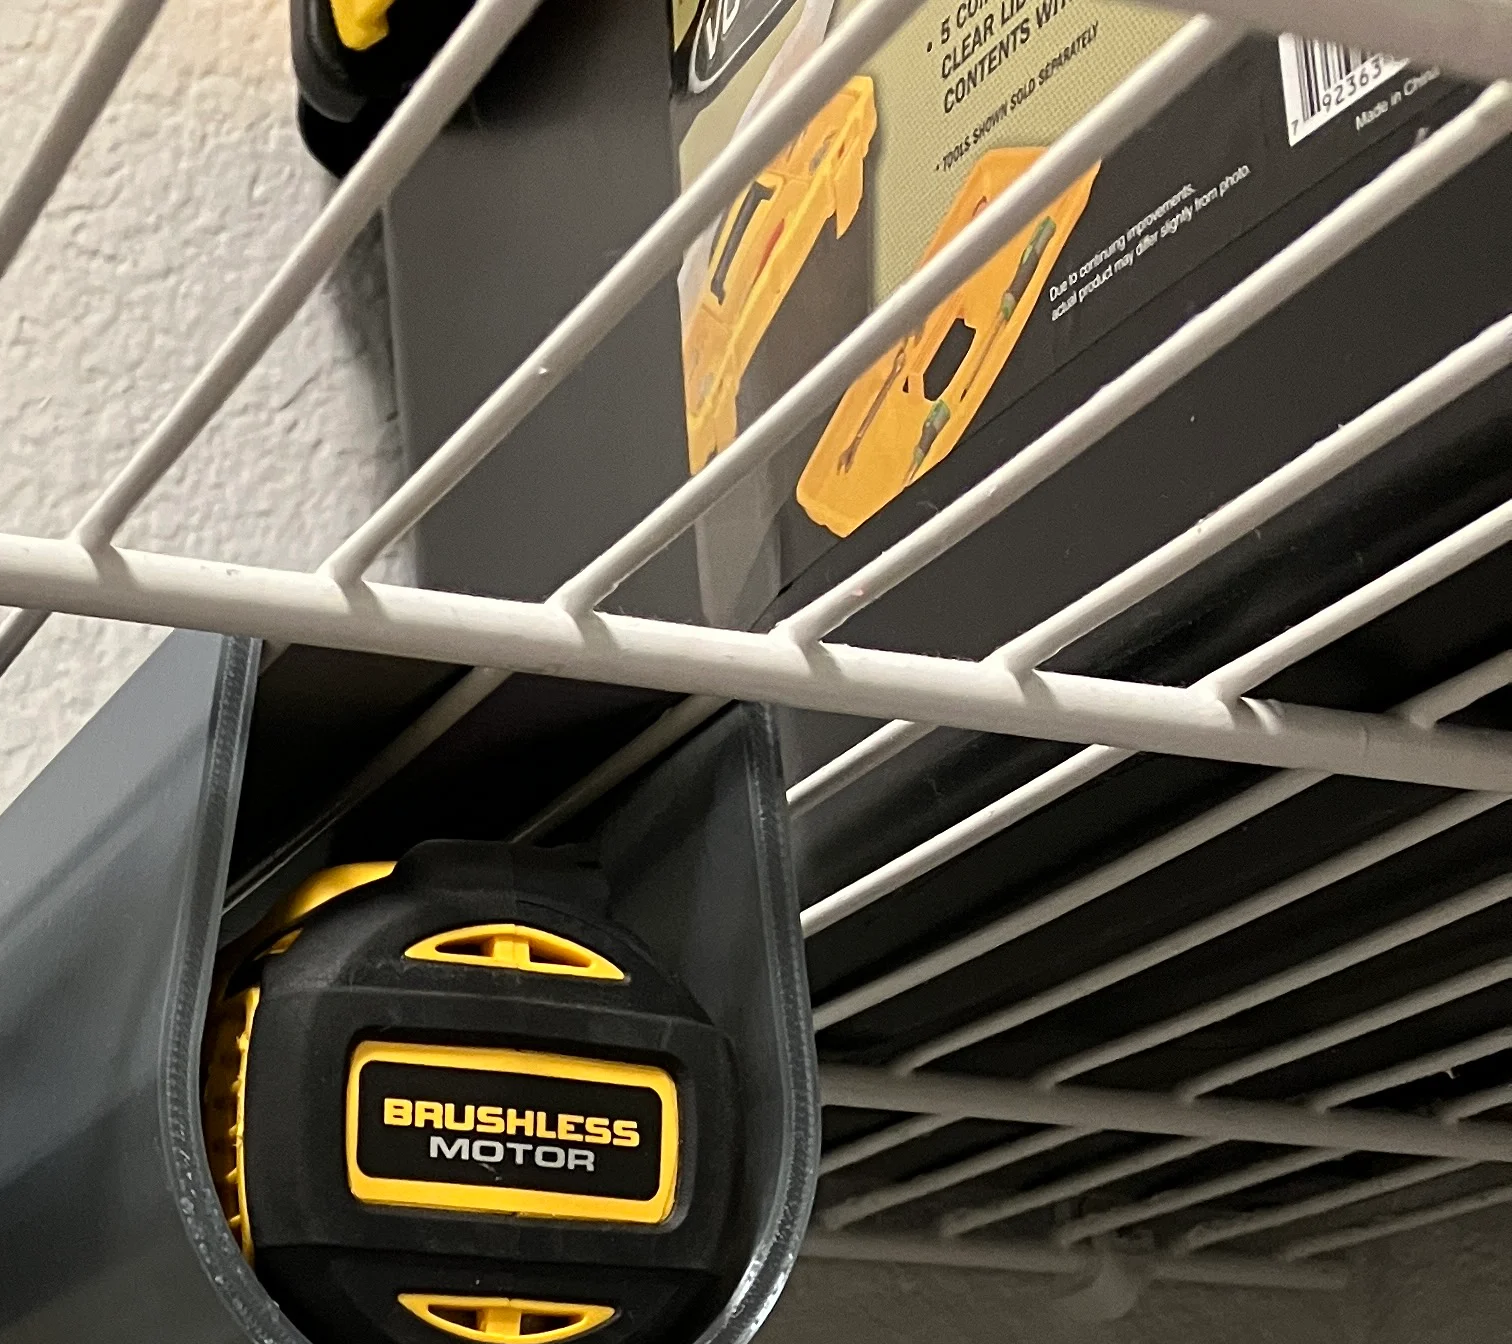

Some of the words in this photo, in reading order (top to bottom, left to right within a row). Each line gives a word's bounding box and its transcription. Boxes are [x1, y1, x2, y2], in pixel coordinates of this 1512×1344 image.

[941, 15, 951, 44] 5
[941, 13, 994, 79] CLEAR
[944, 17, 1030, 113] CONTENTS
[1036, 0, 1069, 28] WI
[973, 100, 1008, 144] SHOWN
[1010, 77, 1036, 110] SOLD
[1039, 20, 1099, 85] SEPARATELY
[1290, 119, 1298, 136] 7
[1355, 100, 1389, 132] Made
[1390, 91, 1402, 106] in
[1049, 281, 1068, 301] Due
[1068, 272, 1078, 285] to
[1079, 235, 1126, 277] continuing
[1052, 291, 1077, 321] actual
[1078, 265, 1113, 302] product
[1114, 250, 1135, 273] may
[1136, 231, 1159, 256] differ
[1160, 205, 1194, 238] slightly
[1194, 188, 1218, 212] from
[383, 1097, 640, 1147] BRUSHLESS
[429, 1136, 595, 1172] MOTOR
